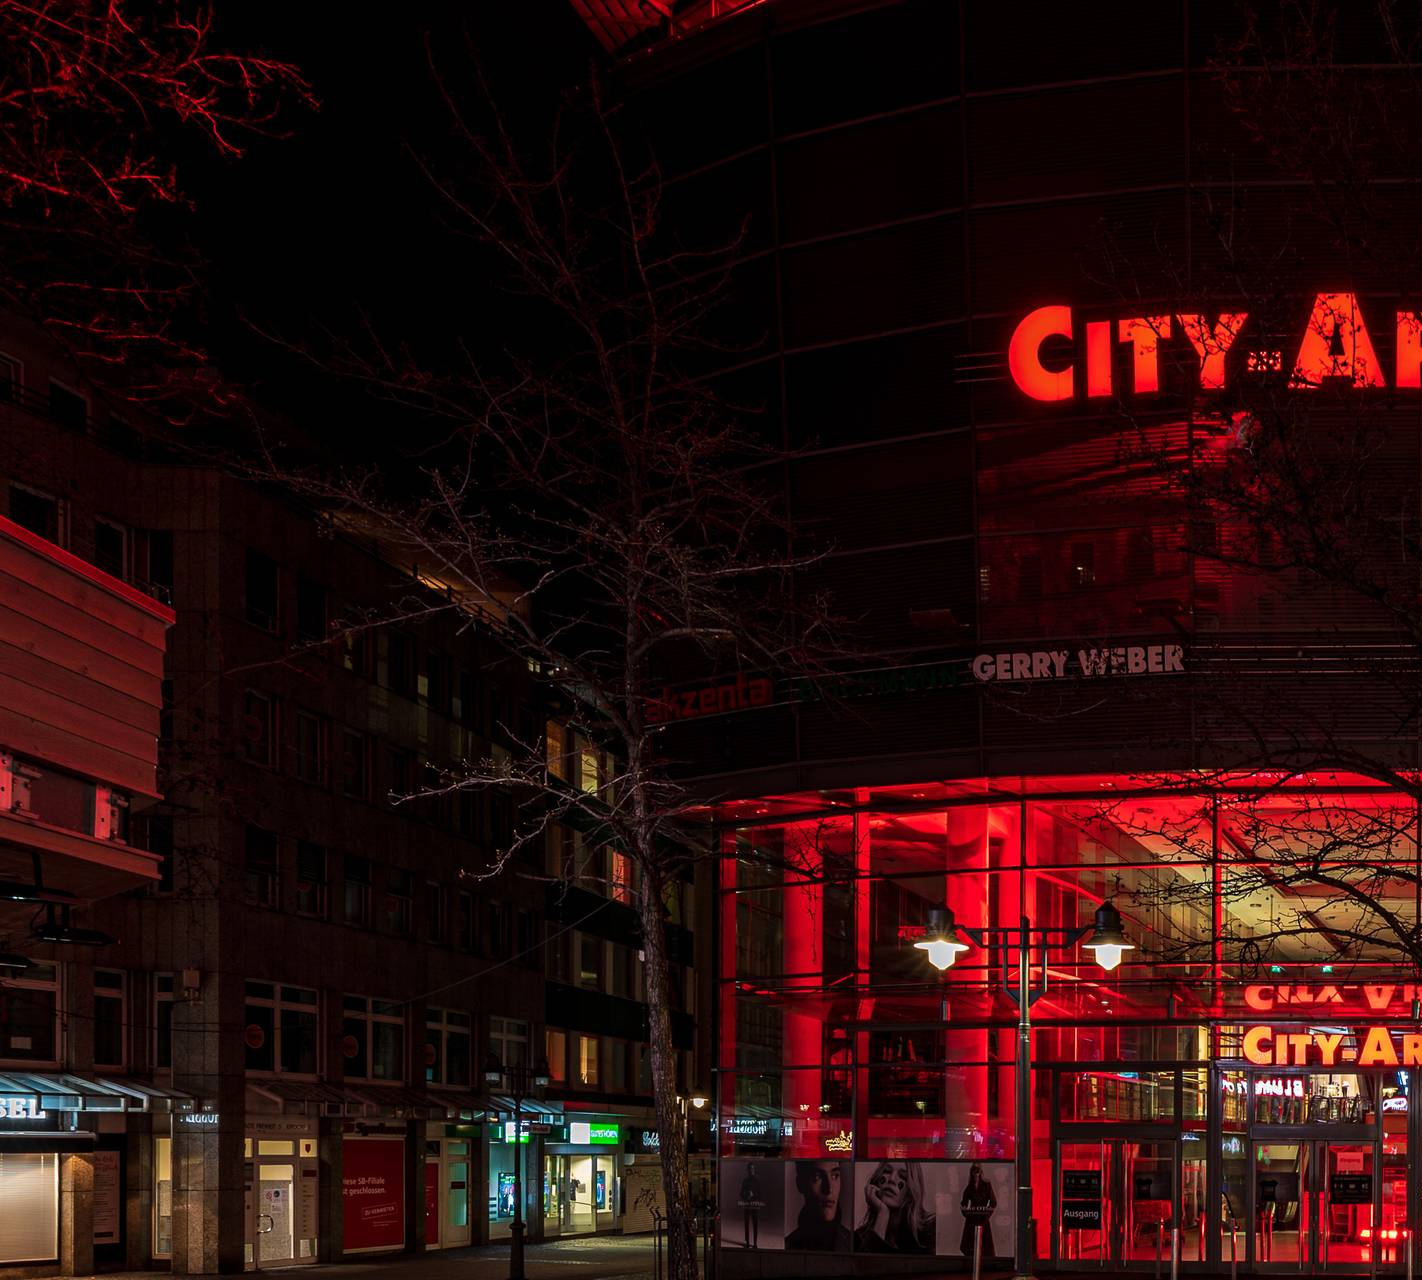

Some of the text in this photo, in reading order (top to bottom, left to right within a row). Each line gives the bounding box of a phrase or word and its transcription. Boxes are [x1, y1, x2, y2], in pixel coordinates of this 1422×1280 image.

[972, 643, 1186, 682] GERRY WEBER
[645, 671, 776, 723] akzenta
[342, 1177, 357, 1185] iese
[1063, 1208, 1099, 1220] Ausgang
